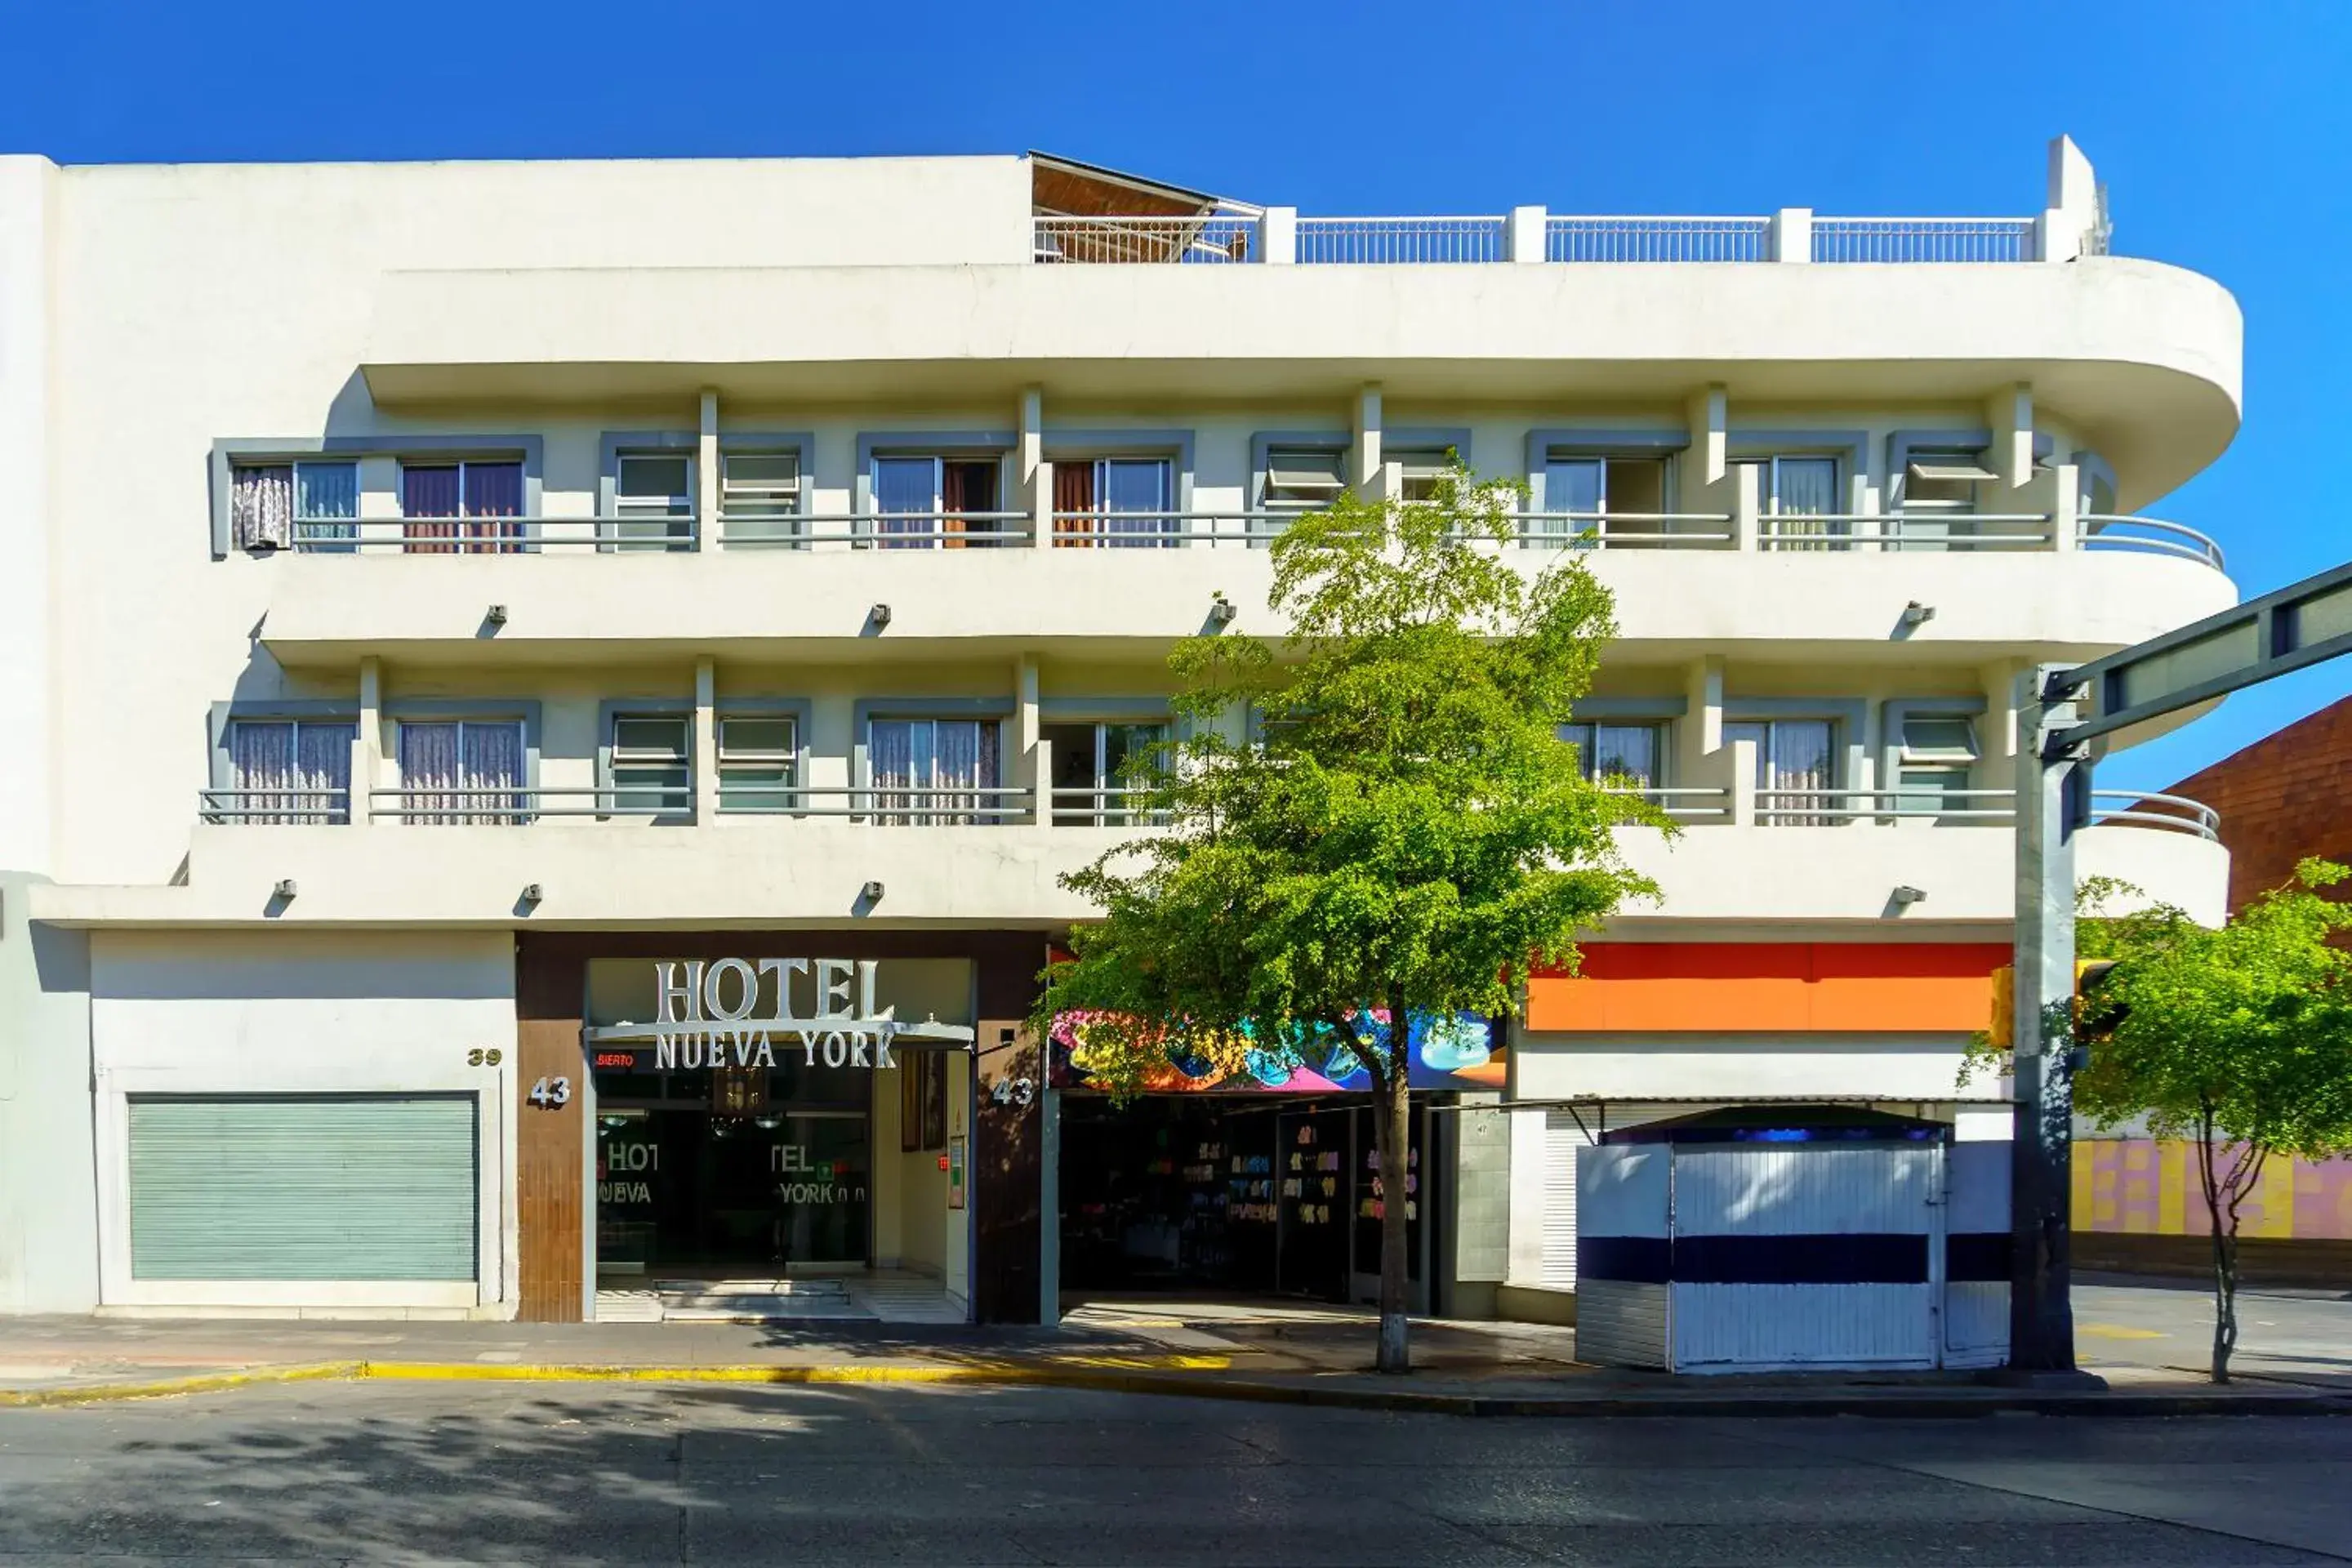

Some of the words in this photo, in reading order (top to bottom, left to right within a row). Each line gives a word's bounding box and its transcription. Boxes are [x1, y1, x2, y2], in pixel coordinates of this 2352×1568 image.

[655, 957, 895, 1022] HOTEL
[467, 1049, 502, 1067] 39
[597, 1054, 634, 1067] BIERTO
[654, 1029, 776, 1068] NUEVA
[798, 1029, 897, 1068] YORK
[531, 1076, 571, 1103] 43
[993, 1077, 1033, 1104] 43
[779, 1183, 834, 1204] YORK
